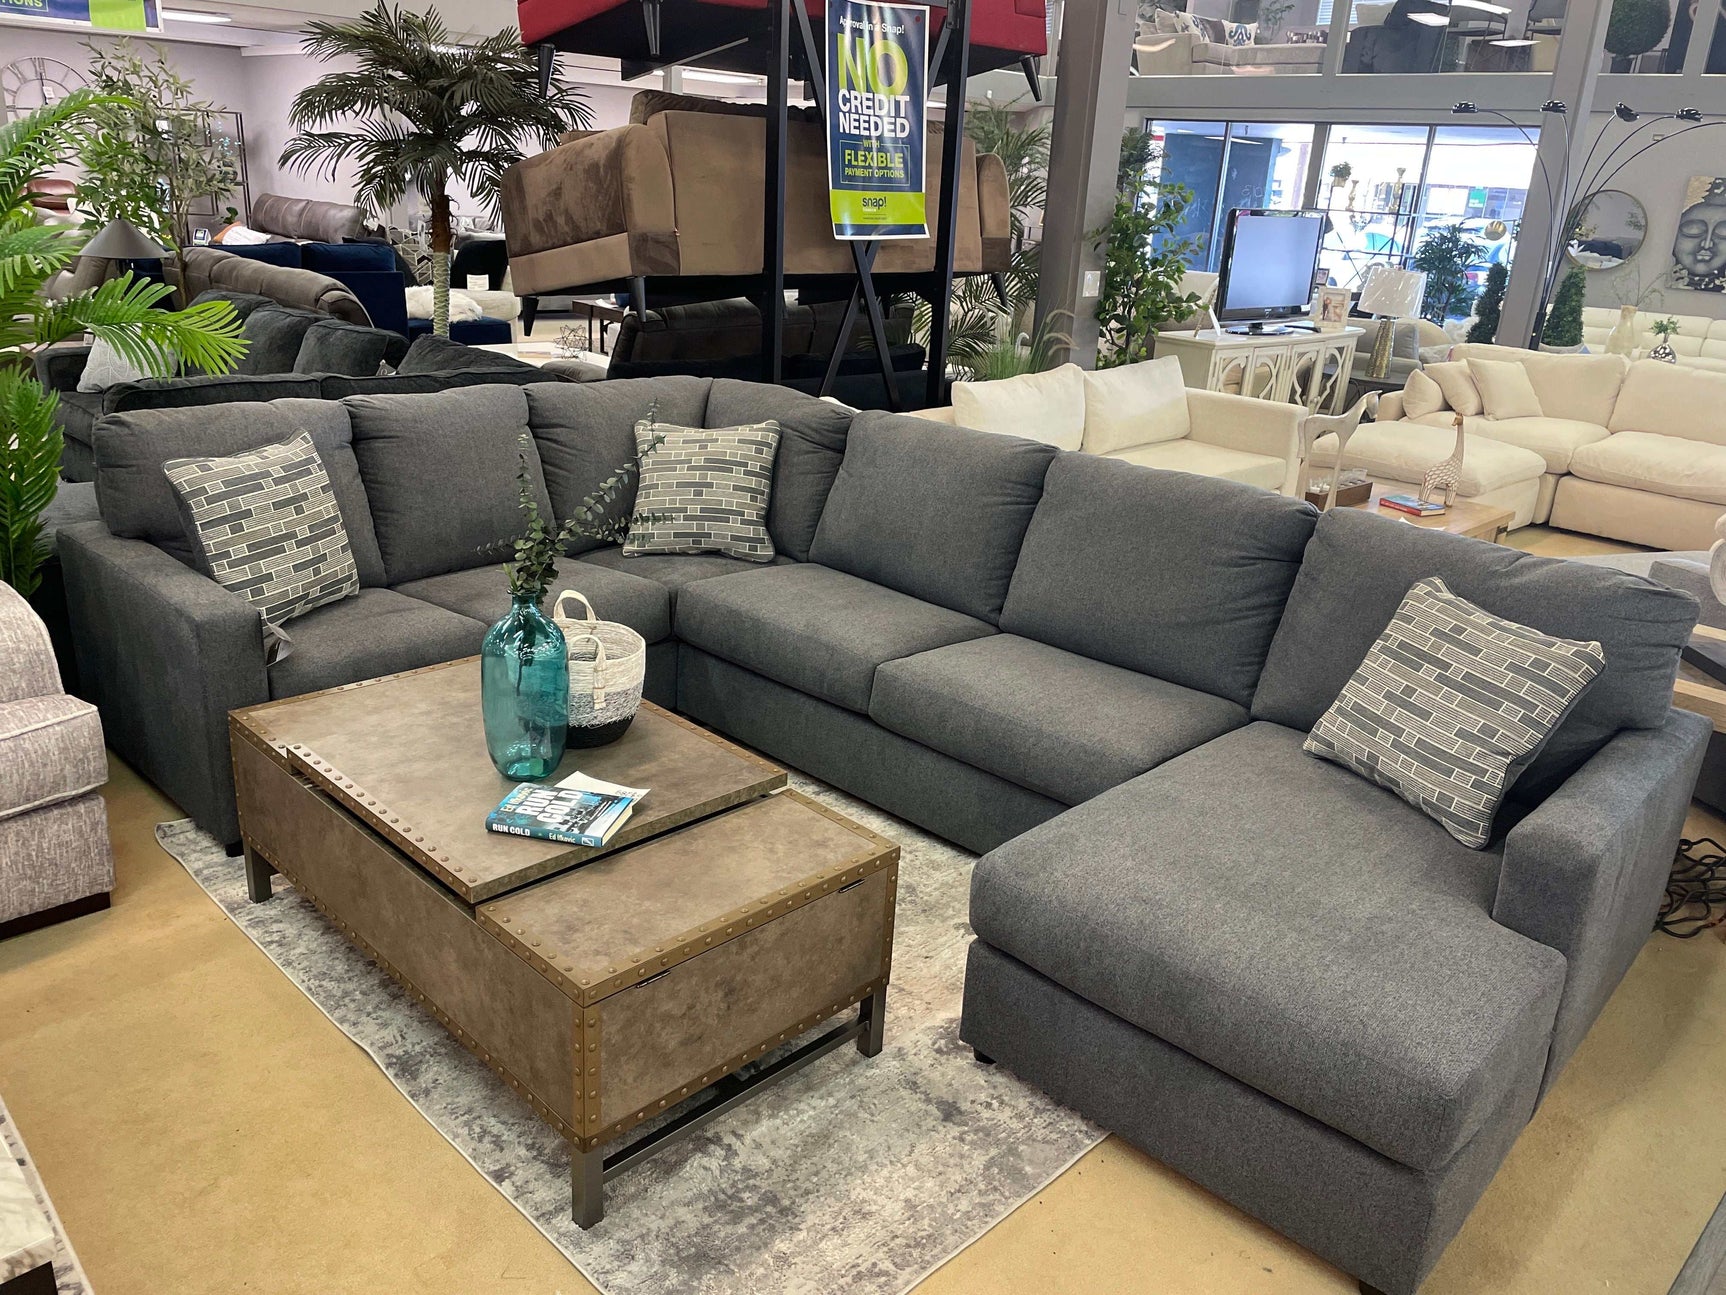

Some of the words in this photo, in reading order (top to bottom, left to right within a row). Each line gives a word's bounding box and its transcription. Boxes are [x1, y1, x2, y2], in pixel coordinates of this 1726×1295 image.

[881, 23, 905, 35] Snap!
[837, 33, 909, 97] NO
[838, 89, 910, 117] CREDIT
[839, 112, 910, 138] NEEDED
[863, 139, 880, 148] WITH
[844, 149, 904, 168] FLEXIBLE
[844, 167, 873, 177] PAYMENT
[874, 169, 905, 178] OPTIONS
[862, 196, 887, 210] snap!
[515, 789, 558, 816] RUN
[537, 790, 585, 823] COLD
[492, 823, 509, 834] RUN
[509, 826, 531, 837] COLD
[548, 832, 557, 841] Ed
